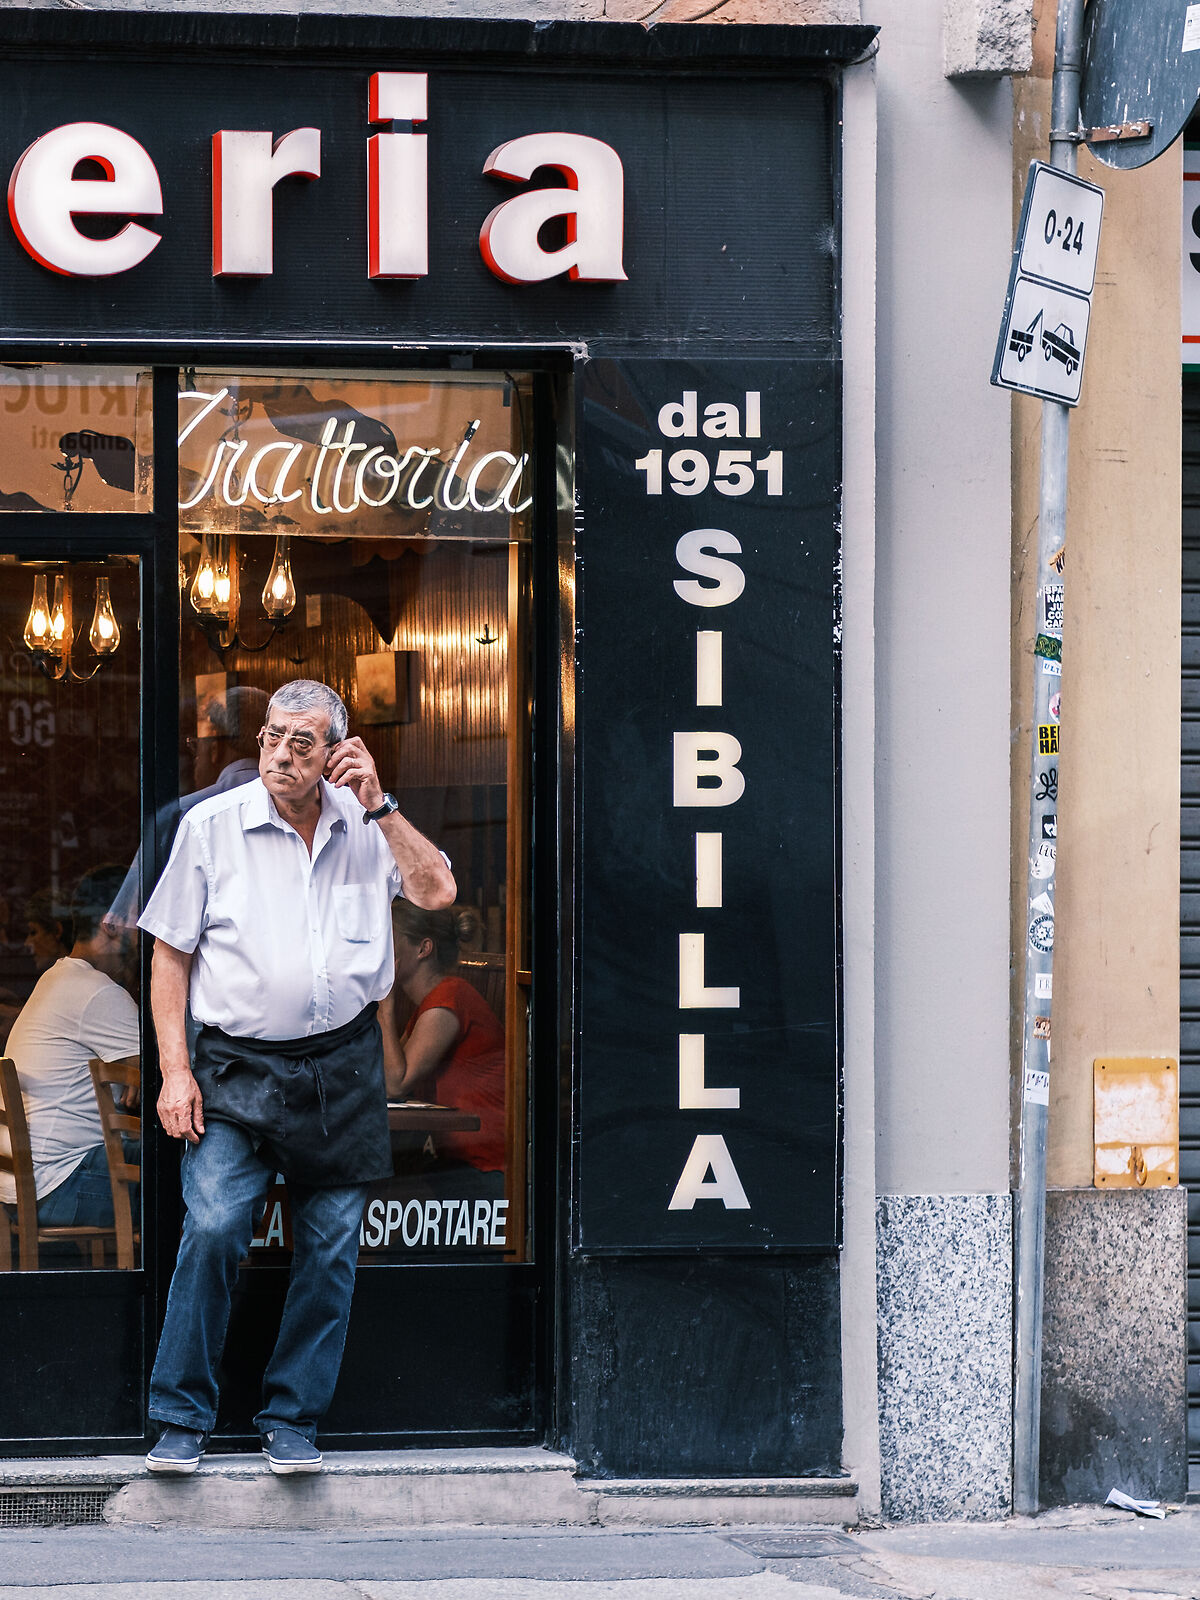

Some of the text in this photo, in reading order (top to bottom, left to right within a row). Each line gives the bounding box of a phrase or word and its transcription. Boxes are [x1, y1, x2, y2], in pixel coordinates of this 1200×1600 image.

[1044, 209, 1085, 255] 0-24
[657, 390, 762, 439] dal
[178, 387, 534, 514] Trattoria
[635, 449, 784, 497] 1951
[1039, 726, 1060, 739] BE
[667, 528, 751, 1211] SIBILLA
[359, 1199, 510, 1248] SPORTARE
